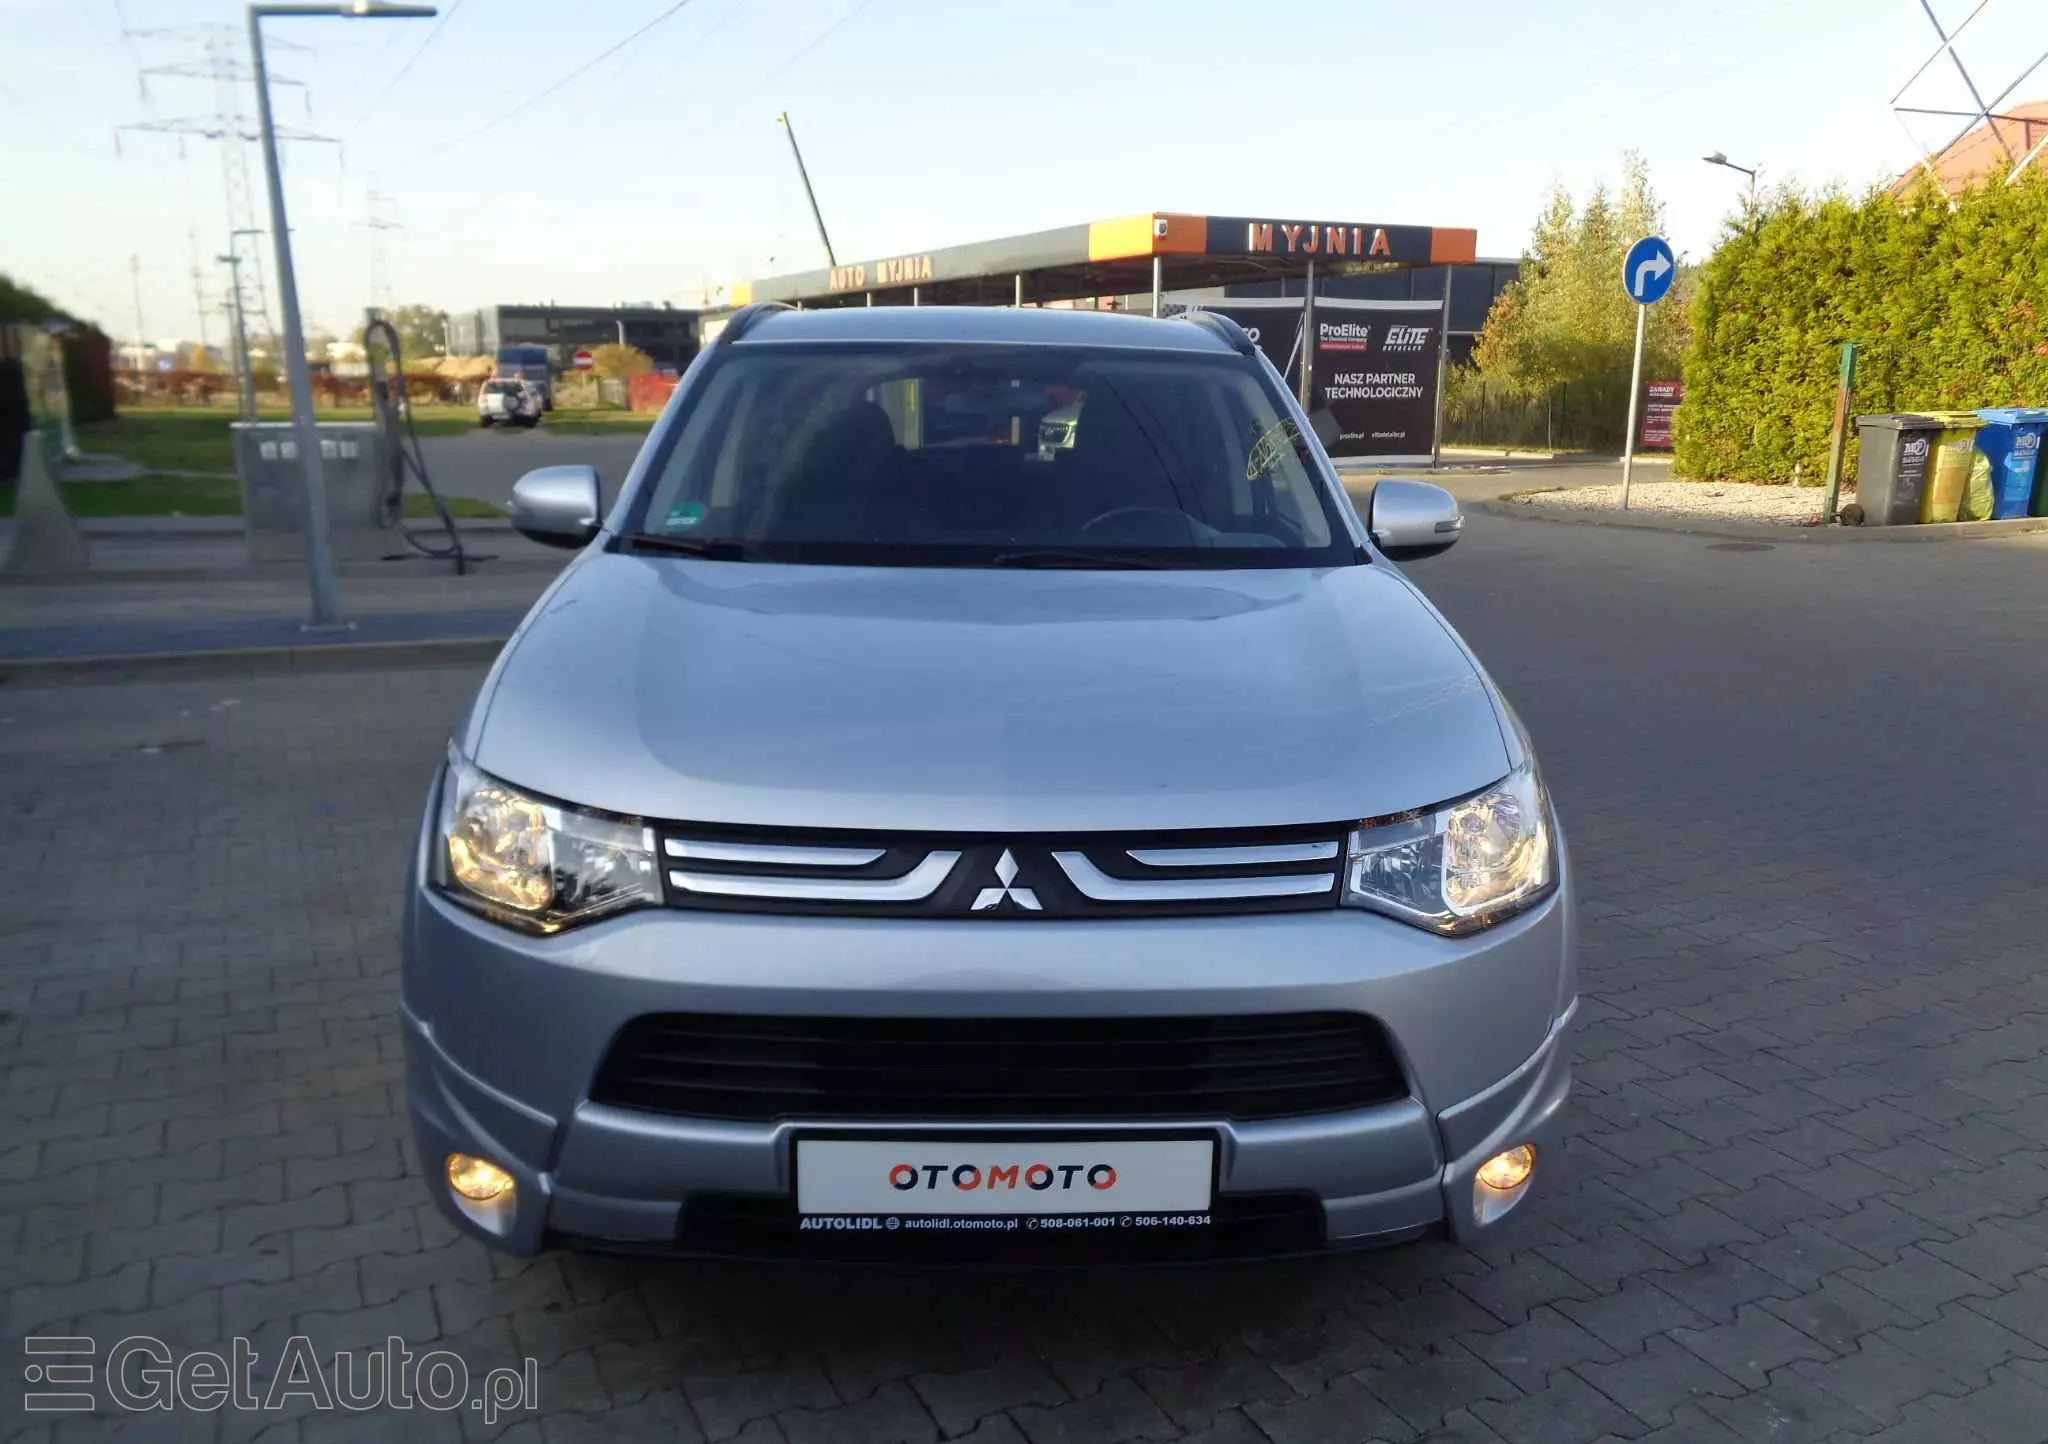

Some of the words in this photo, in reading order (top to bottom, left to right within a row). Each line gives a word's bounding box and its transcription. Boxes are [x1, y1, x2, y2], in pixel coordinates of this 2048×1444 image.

[1249, 223, 1391, 256] MYJNIA
[830, 265, 865, 291] AUTO
[1320, 323, 1368, 337] ProElite
[1334, 373, 1364, 385] NASZ
[1366, 373, 1416, 385] PARTNER
[1324, 386, 1424, 399] TECHNOLOGICZNY
[888, 1163, 1118, 1191] OTOMOTO
[800, 1217, 882, 1230] AUTOLIDL
[905, 1218, 1018, 1231] autolidl.otomoto.pl
[1040, 1217, 1115, 1228] 508-061-001
[1135, 1215, 1211, 1226] 506-140-634
